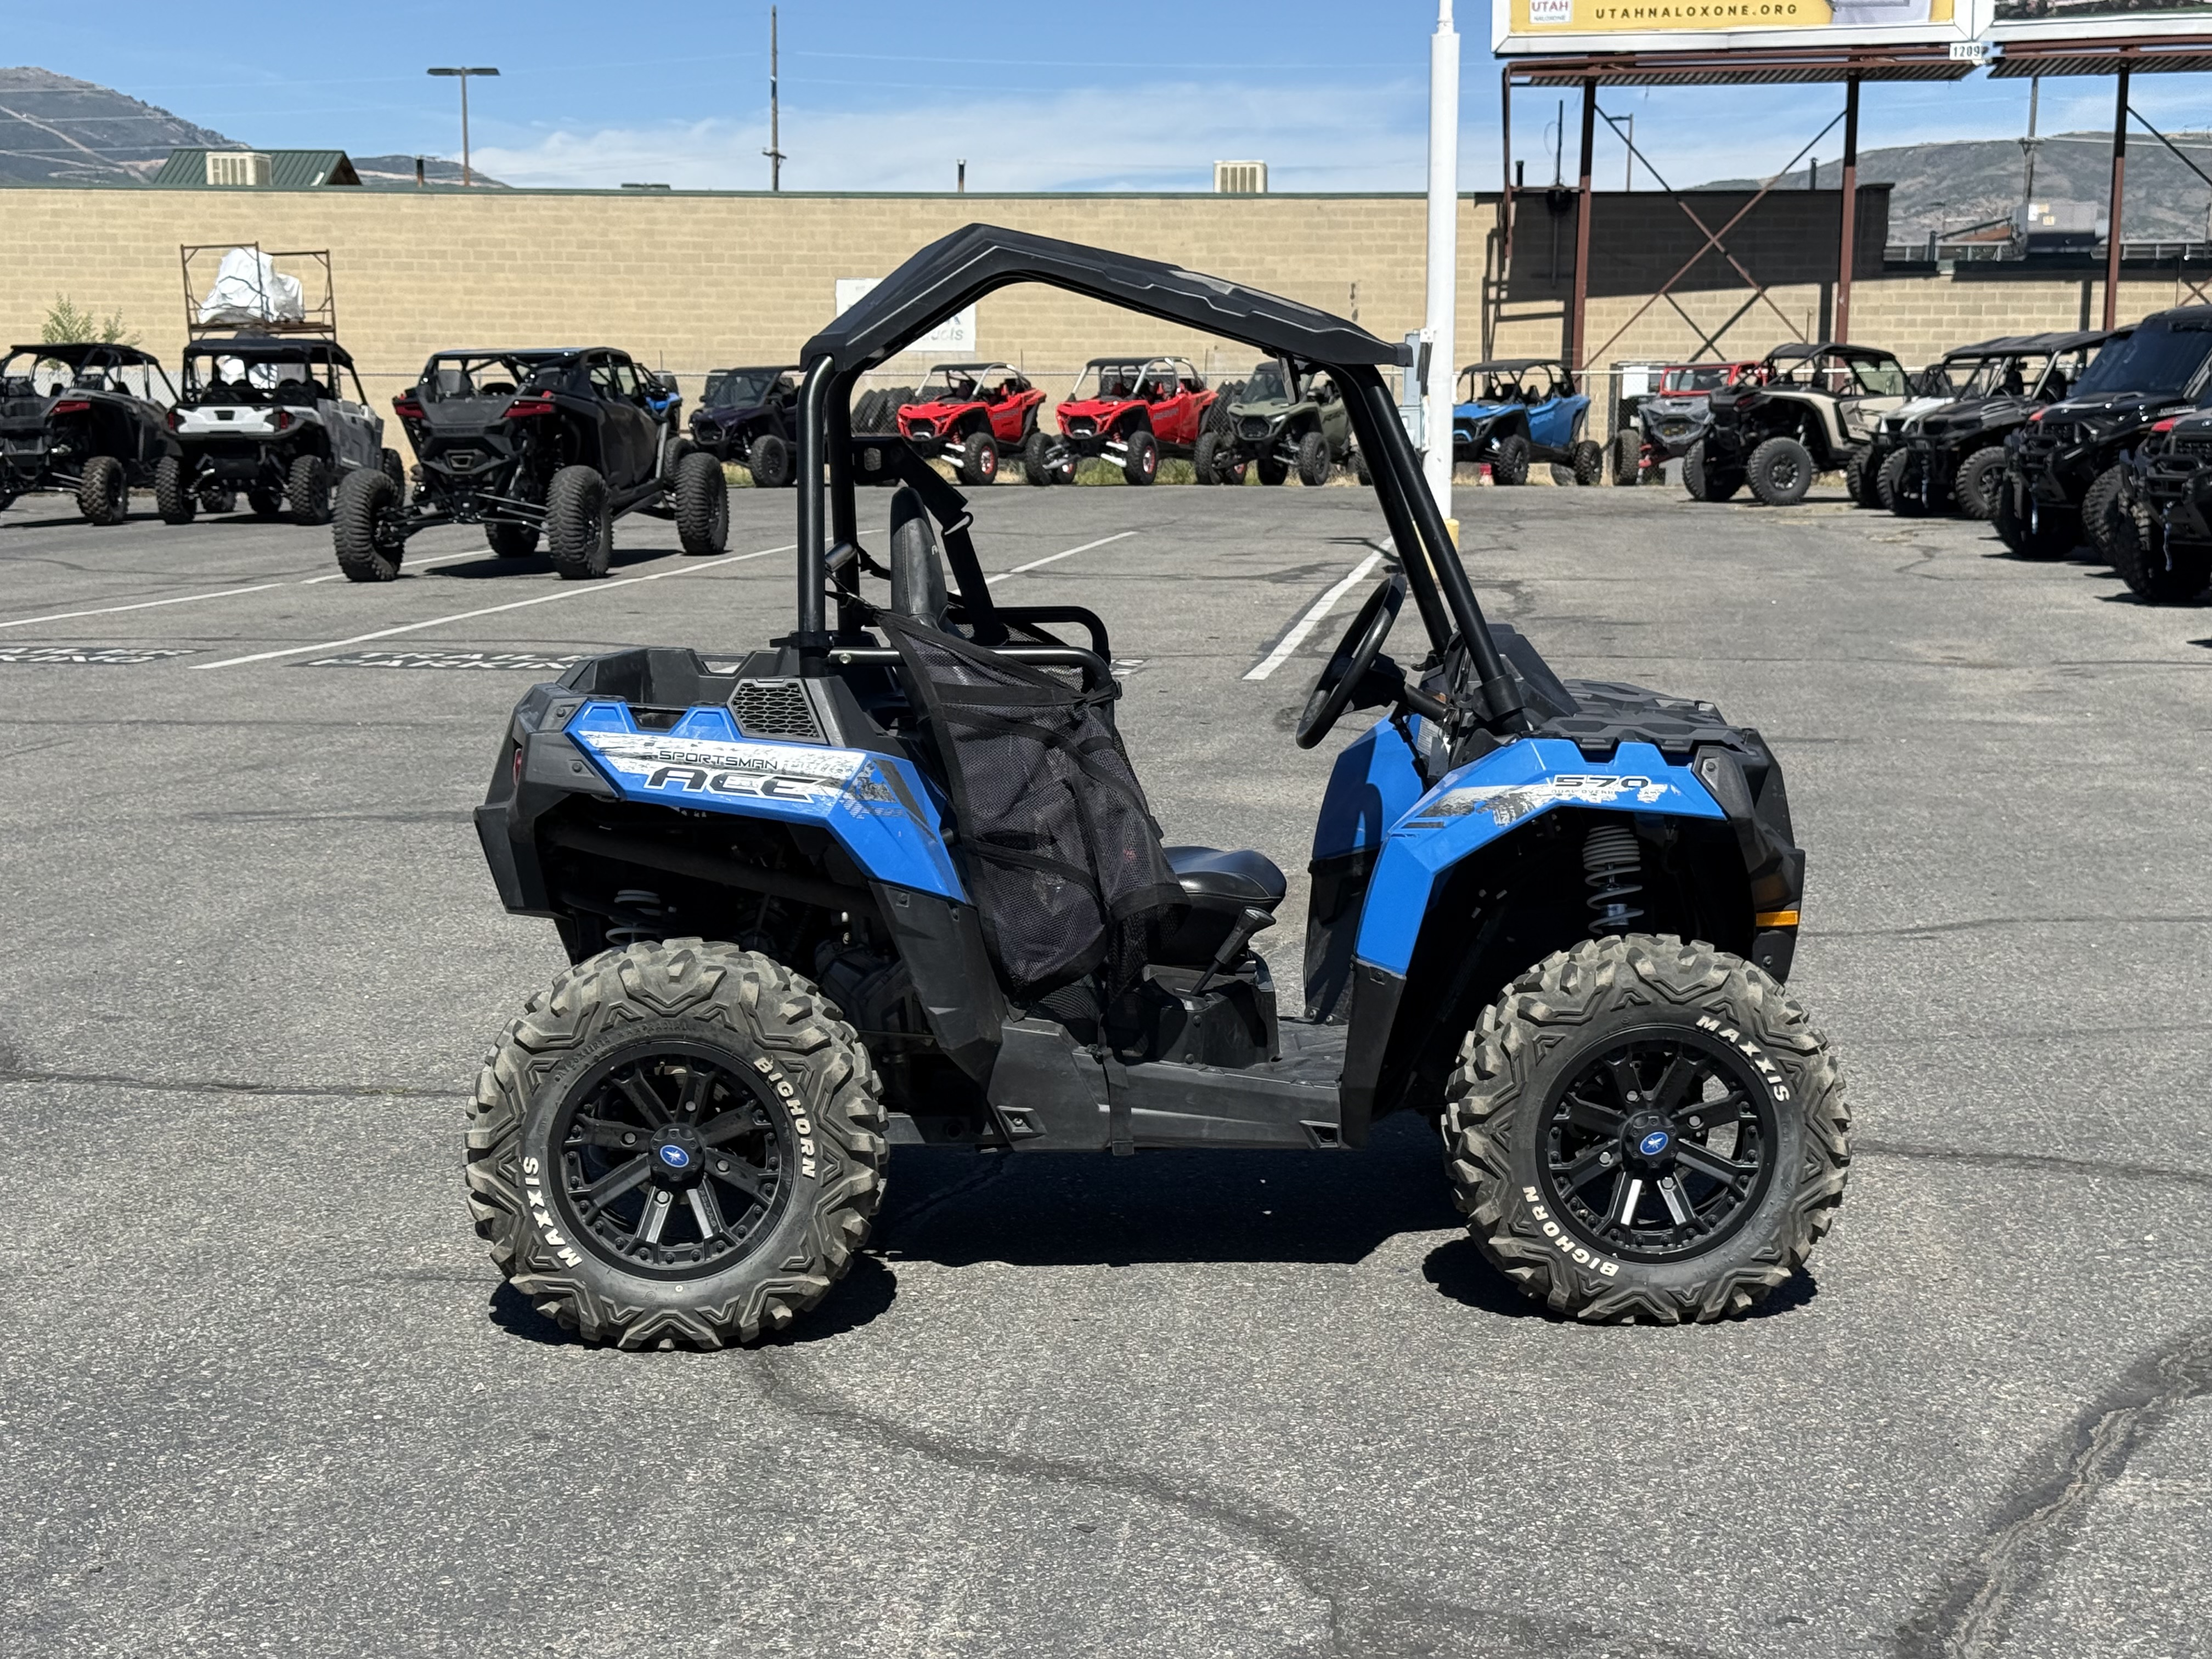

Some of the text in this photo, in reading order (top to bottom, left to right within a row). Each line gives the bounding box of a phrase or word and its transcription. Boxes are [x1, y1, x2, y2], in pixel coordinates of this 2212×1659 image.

[1531, 1, 1568, 12] UTAH
[1595, 4, 1798, 19] UTAHNALOXONE.ORG
[1953, 45, 1980, 58] 1209
[658, 750, 778, 770] SPORTSMAN
[645, 766, 820, 803] ACE
[1555, 776, 1650, 789] 570
[1696, 1015, 1790, 1103] MAXXIS
[753, 1056, 816, 1180] BIGHORN
[523, 1156, 583, 1267] MAXXIS
[1522, 1186, 1619, 1278] BIGHORN
